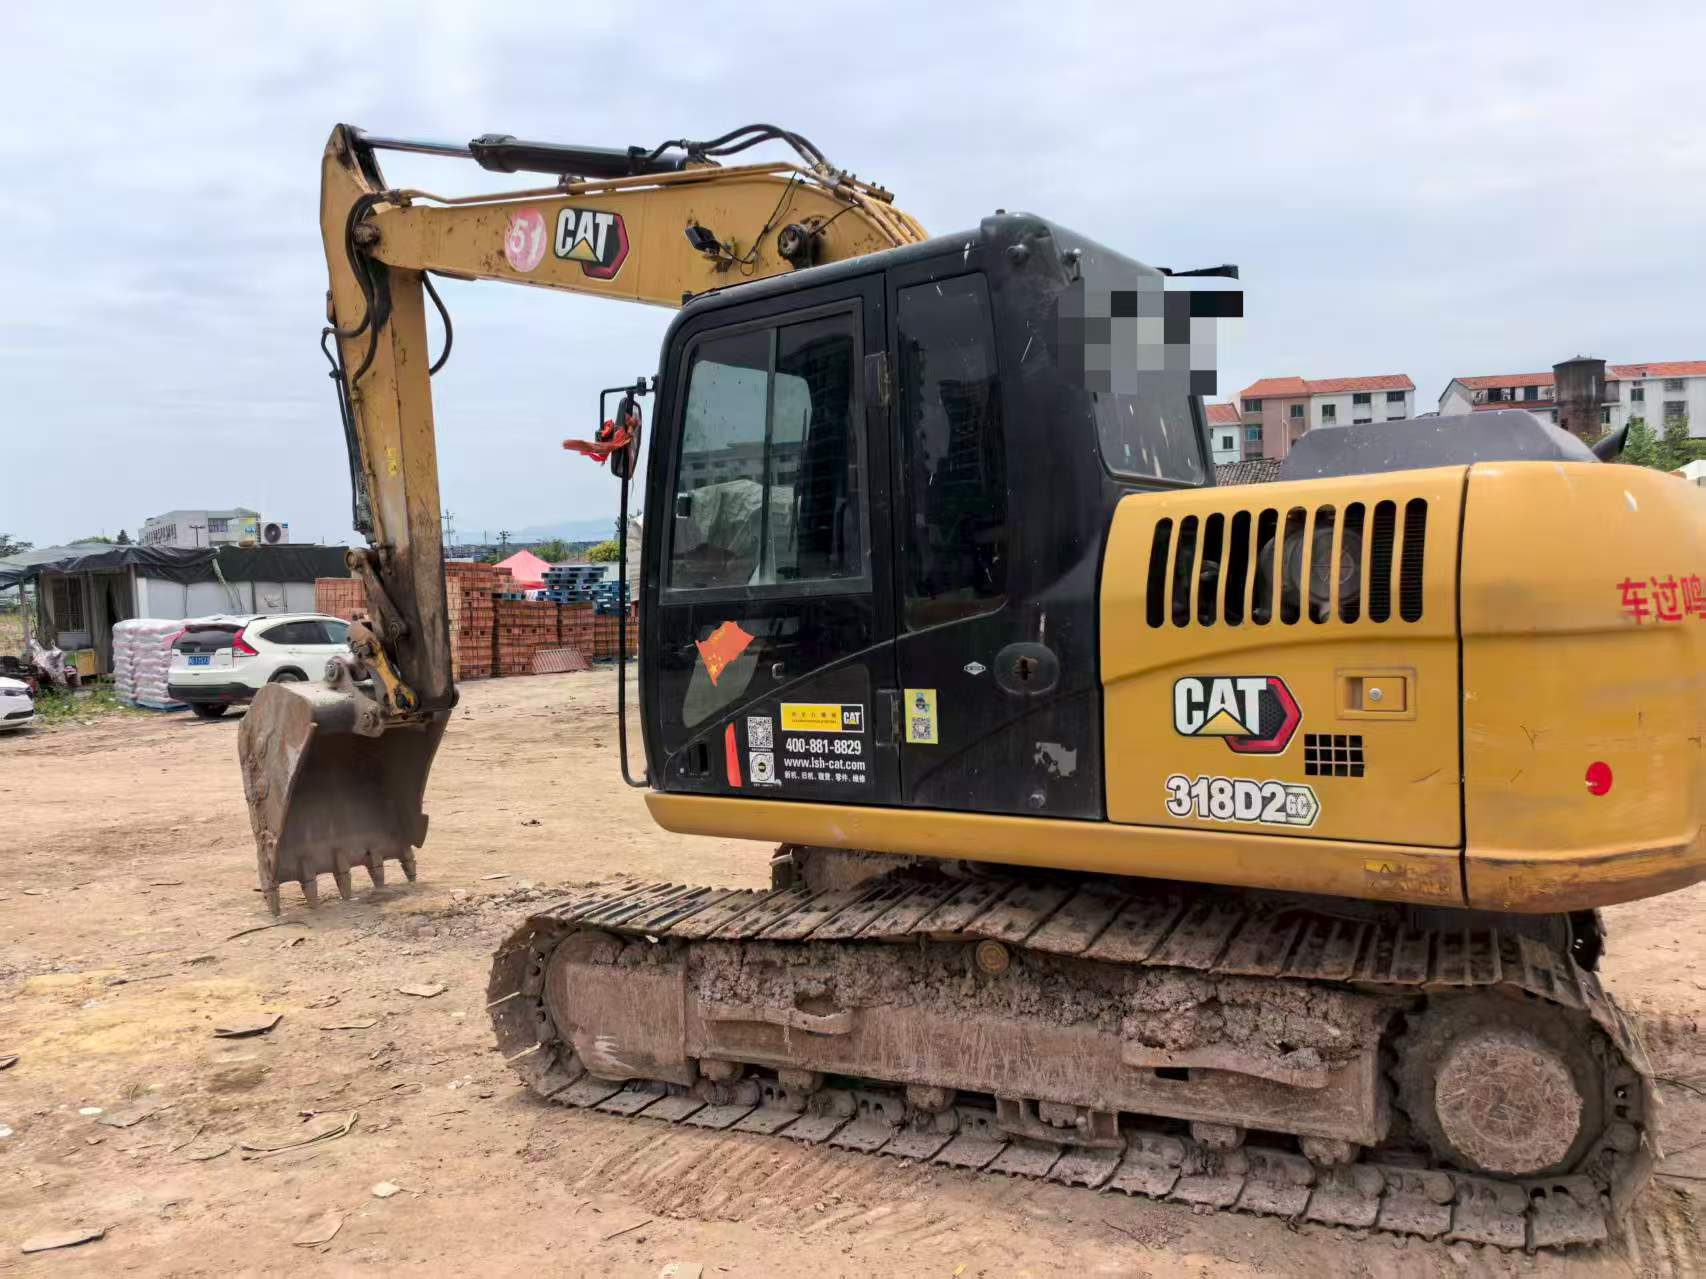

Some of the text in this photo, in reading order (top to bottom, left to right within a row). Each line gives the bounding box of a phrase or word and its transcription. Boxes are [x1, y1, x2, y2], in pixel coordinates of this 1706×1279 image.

[509, 217, 543, 263] 51
[555, 208, 614, 263] CAT
[843, 711, 861, 725] CAT
[1174, 677, 1267, 736] CAT
[783, 756, 866, 771] www.lsh-cat.com
[785, 737, 862, 756] 400-881-8829
[1166, 775, 1288, 824] 318D2
